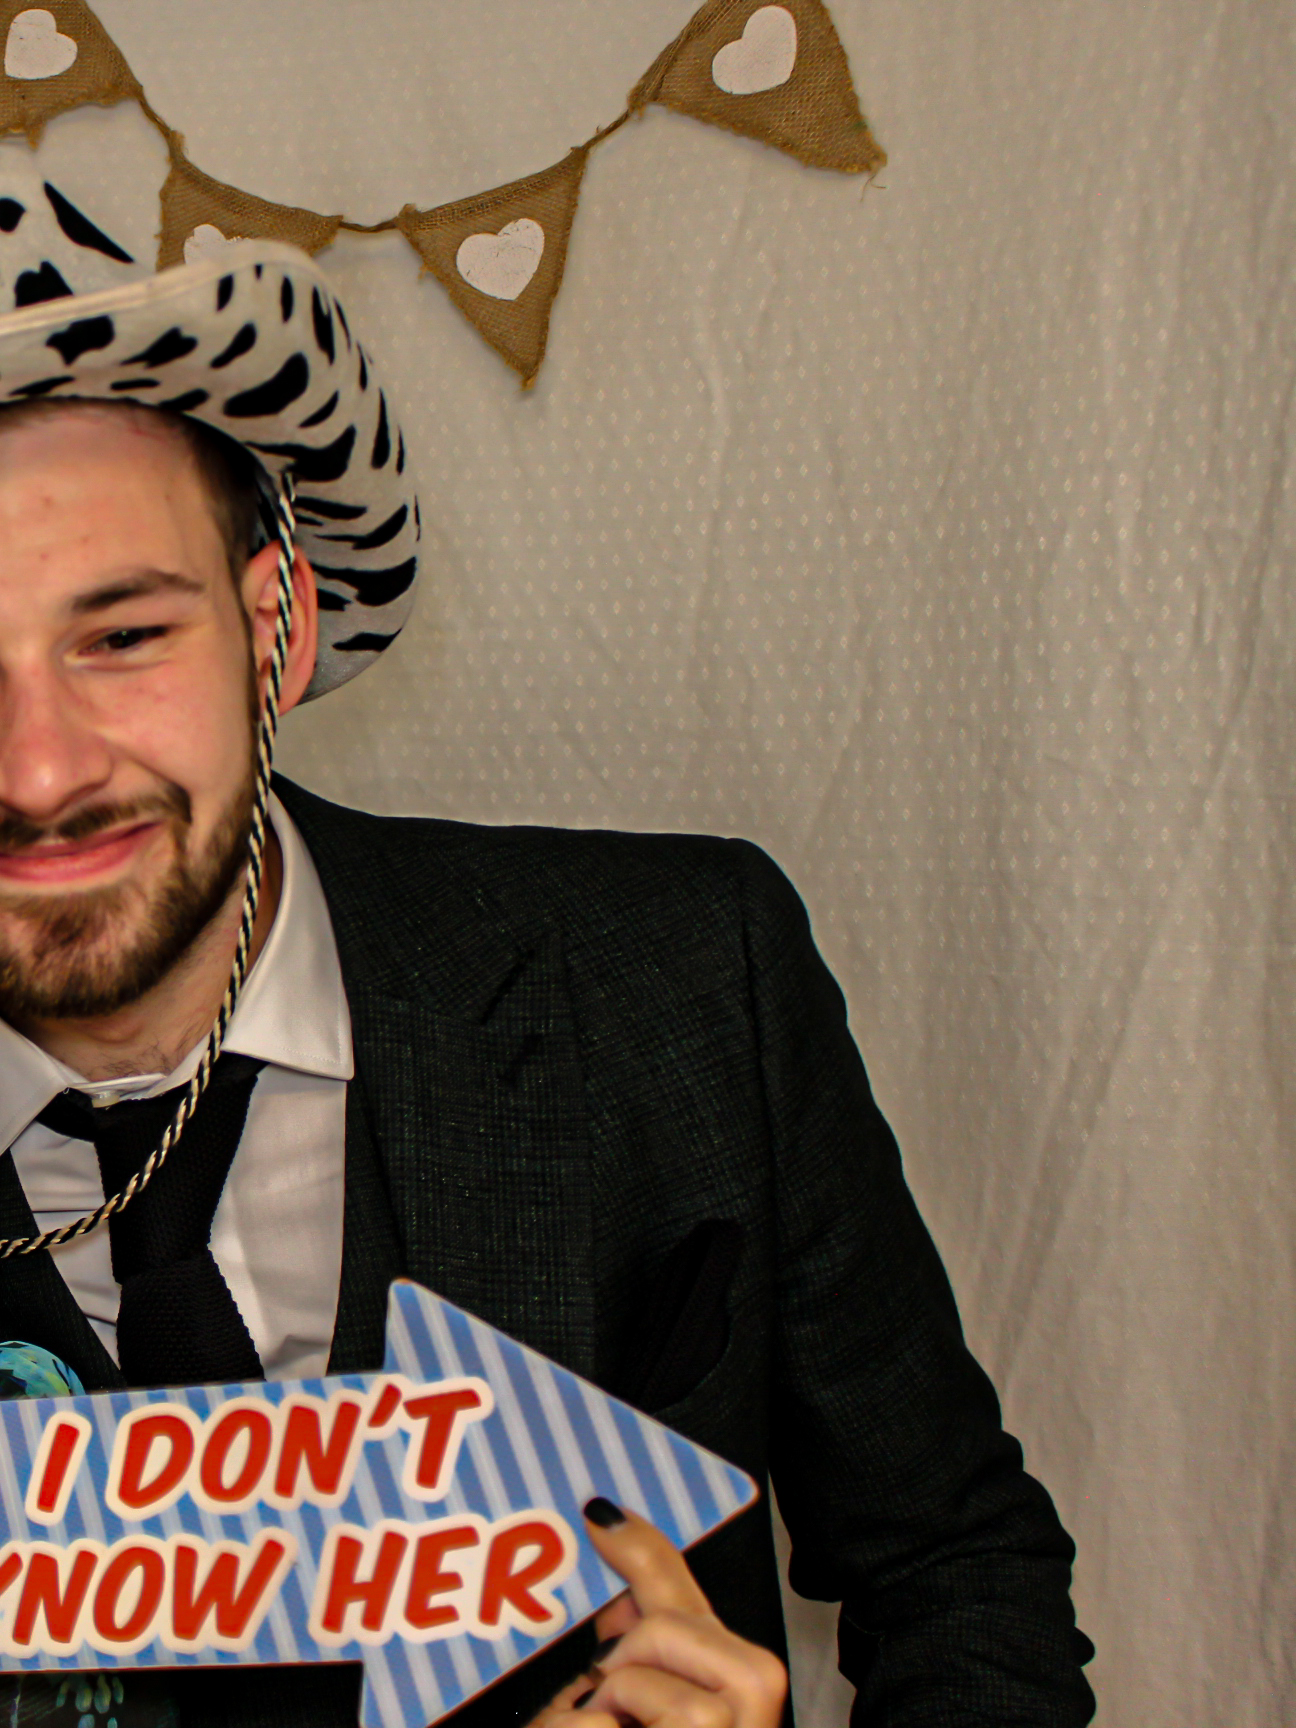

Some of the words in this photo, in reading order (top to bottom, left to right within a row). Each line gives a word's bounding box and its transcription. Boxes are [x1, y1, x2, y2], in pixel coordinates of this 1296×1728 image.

[36, 1422, 80, 1514] I
[117, 1383, 481, 1510] DON'T
[321, 1520, 565, 1634] HER
